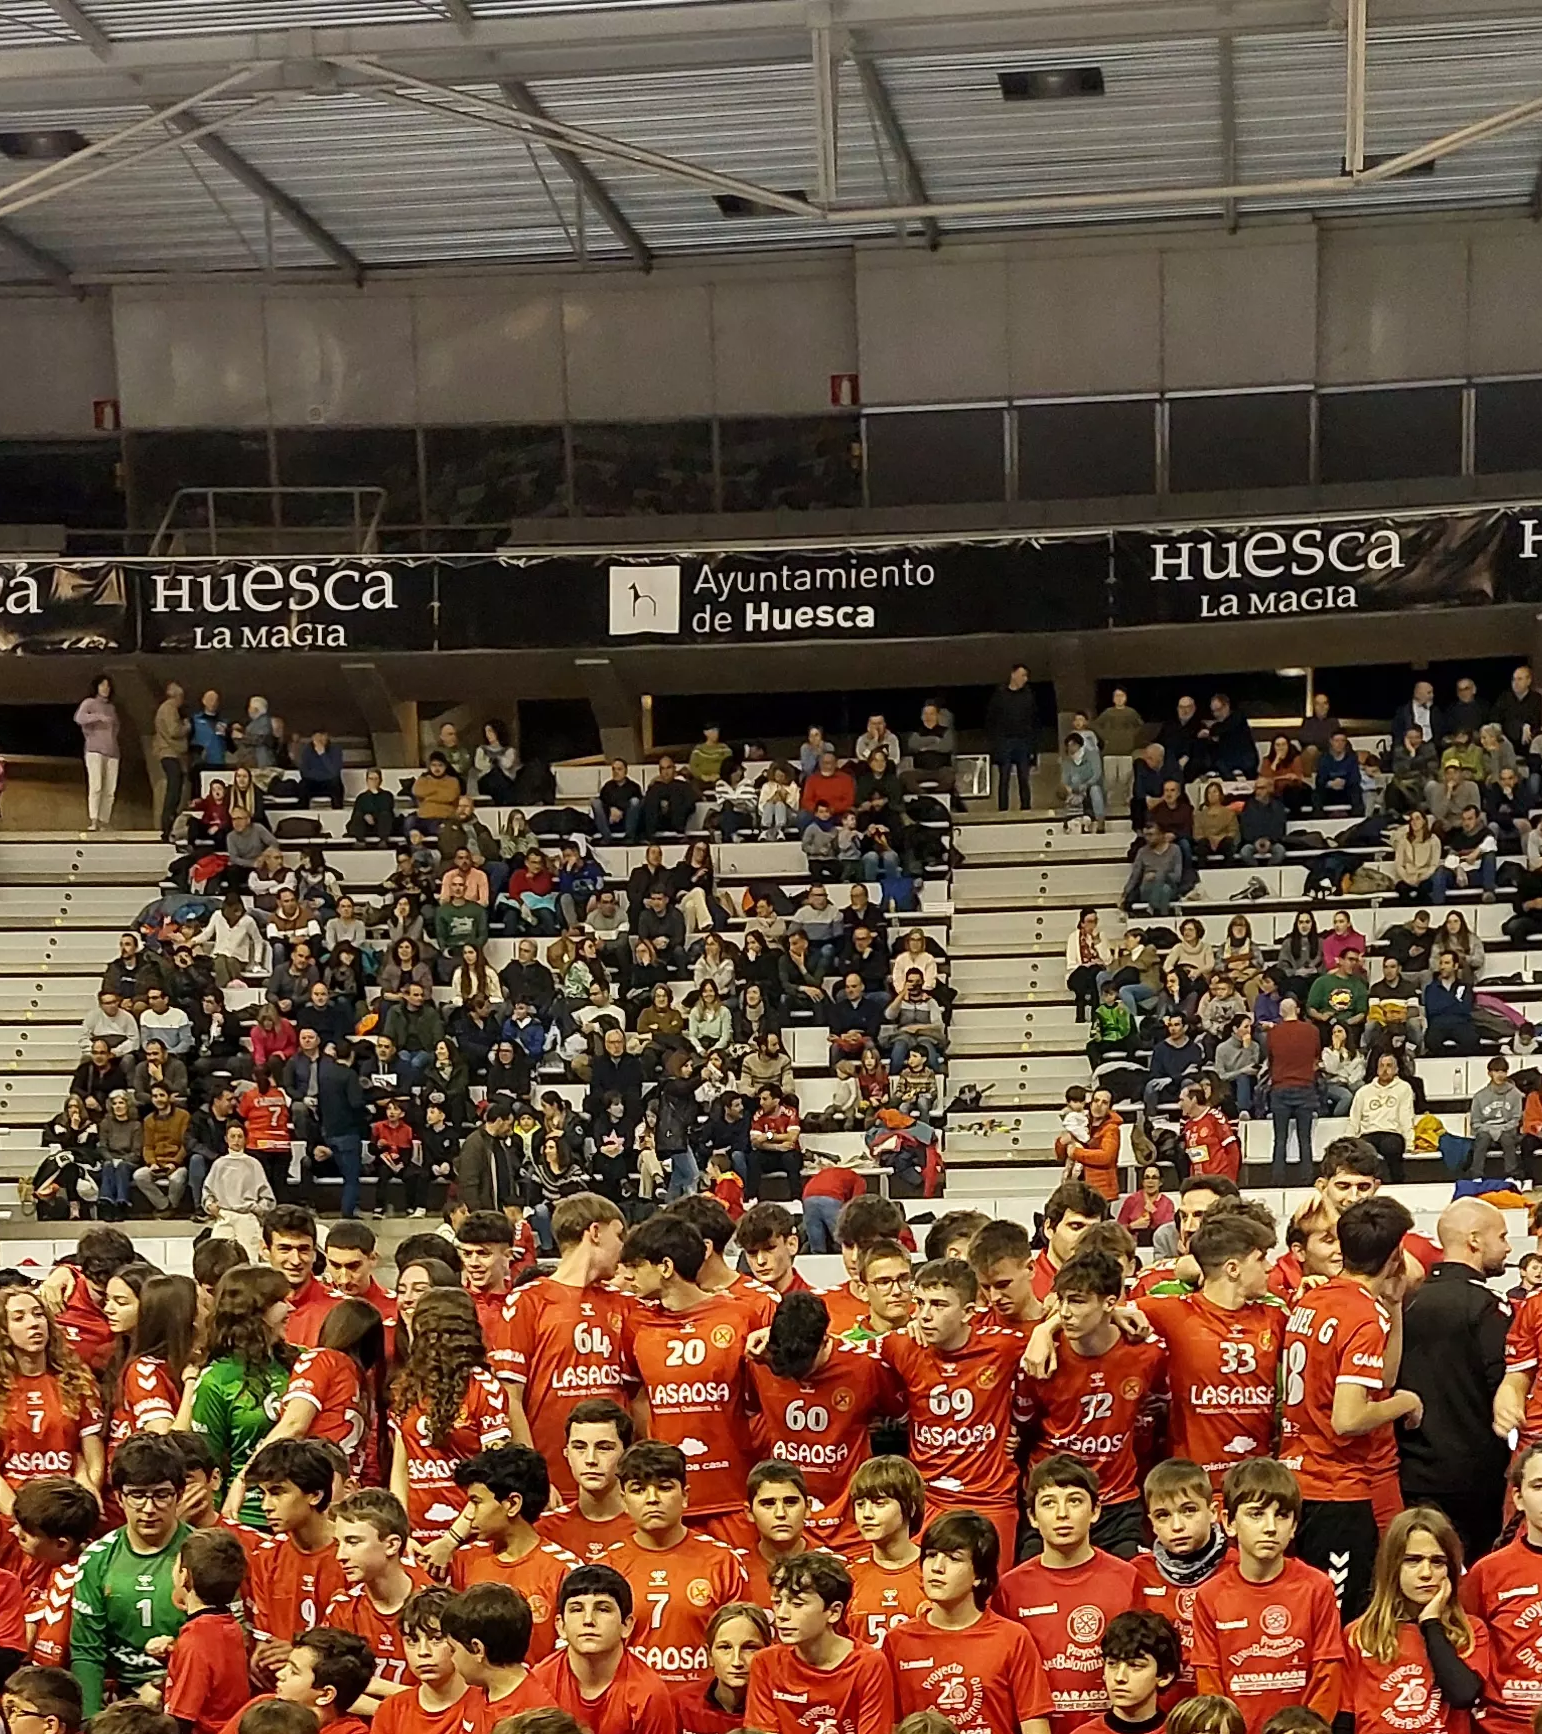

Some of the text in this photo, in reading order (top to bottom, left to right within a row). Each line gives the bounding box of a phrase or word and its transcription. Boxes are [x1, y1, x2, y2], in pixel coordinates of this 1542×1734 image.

[693, 558, 936, 597] Ayuntamiento
[692, 601, 876, 634] de Huesca
[573, 1321, 612, 1358] 64
[665, 1338, 706, 1367] 20
[1219, 1341, 1257, 1374] 33
[552, 1364, 623, 1389] LASAOS
[785, 1399, 829, 1432] 60
[929, 1385, 974, 1422] 69
[1081, 1394, 1113, 1425] 32
[29, 1410, 44, 1433] 7
[773, 1440, 848, 1465] ASAOSA
[136, 1598, 153, 1626] 1
[300, 1598, 316, 1632] 9
[646, 1592, 670, 1629] 7
[868, 1613, 909, 1650] 5
[630, 1645, 708, 1670] ASAOSA
[1066, 1642, 1104, 1658] Proyect
[921, 1661, 965, 1690] Proyecto
[1380, 1663, 1424, 1692] Proyecto
